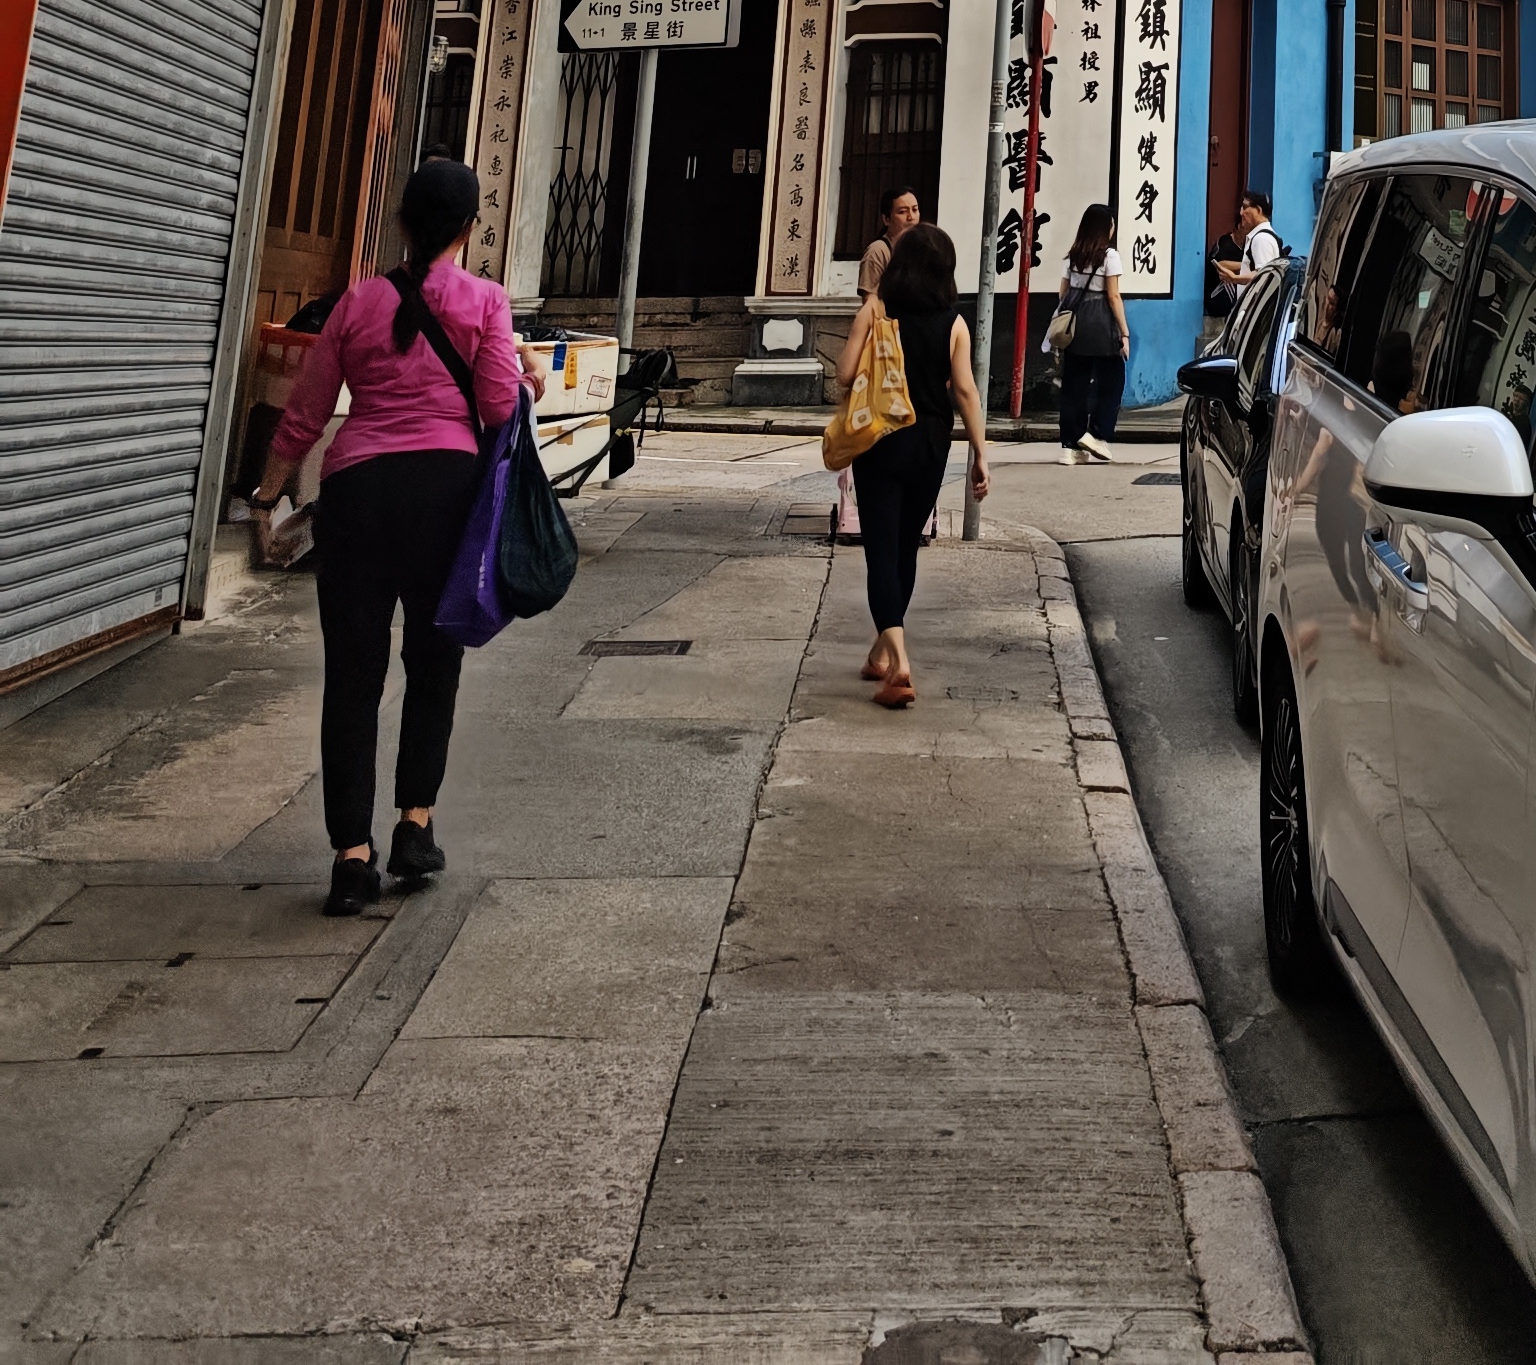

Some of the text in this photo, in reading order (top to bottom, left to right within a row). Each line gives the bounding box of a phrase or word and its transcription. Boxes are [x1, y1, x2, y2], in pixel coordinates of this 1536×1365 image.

[588, 1, 622, 18] King
[629, 0, 663, 17] Sing
[620, 20, 684, 41] 景星街
